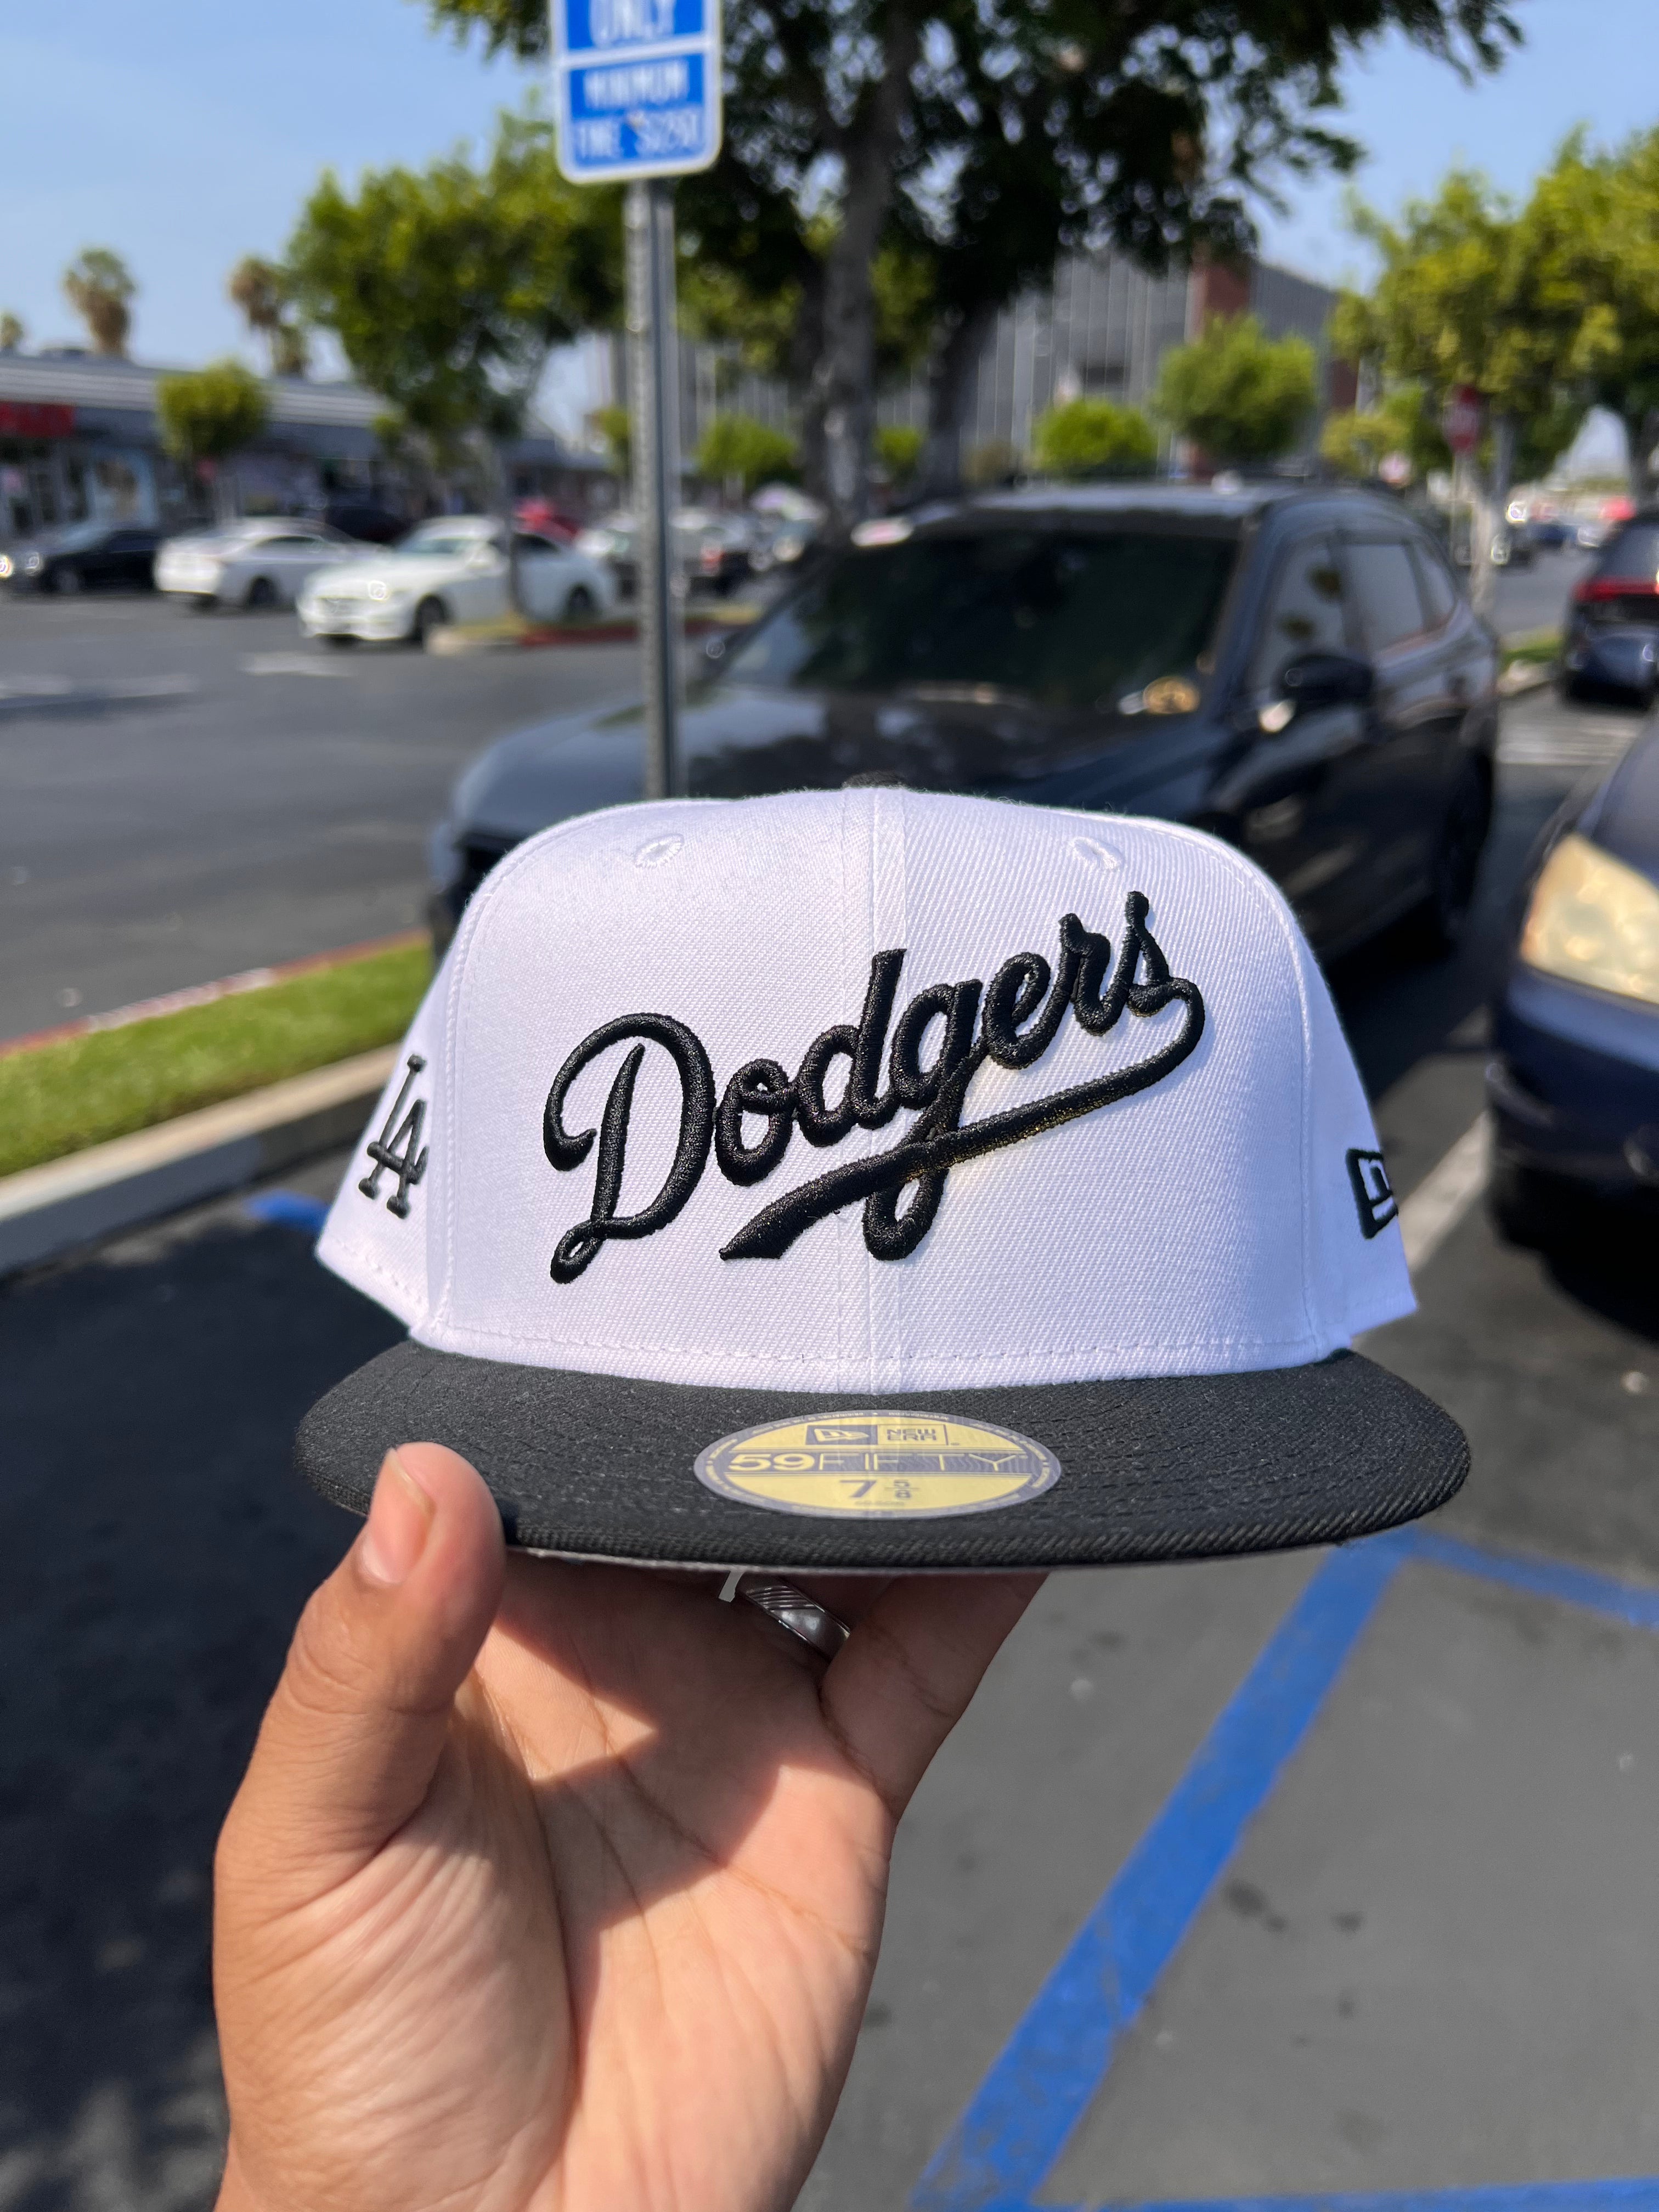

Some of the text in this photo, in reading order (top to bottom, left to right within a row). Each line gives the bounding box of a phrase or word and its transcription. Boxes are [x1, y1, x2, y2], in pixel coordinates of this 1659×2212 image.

[543, 891, 1205, 1284] Dodgers
[358, 1053, 429, 1219] LA
[727, 1452, 1017, 1471] 59FIFTY
[839, 1479, 878, 1498] 7
